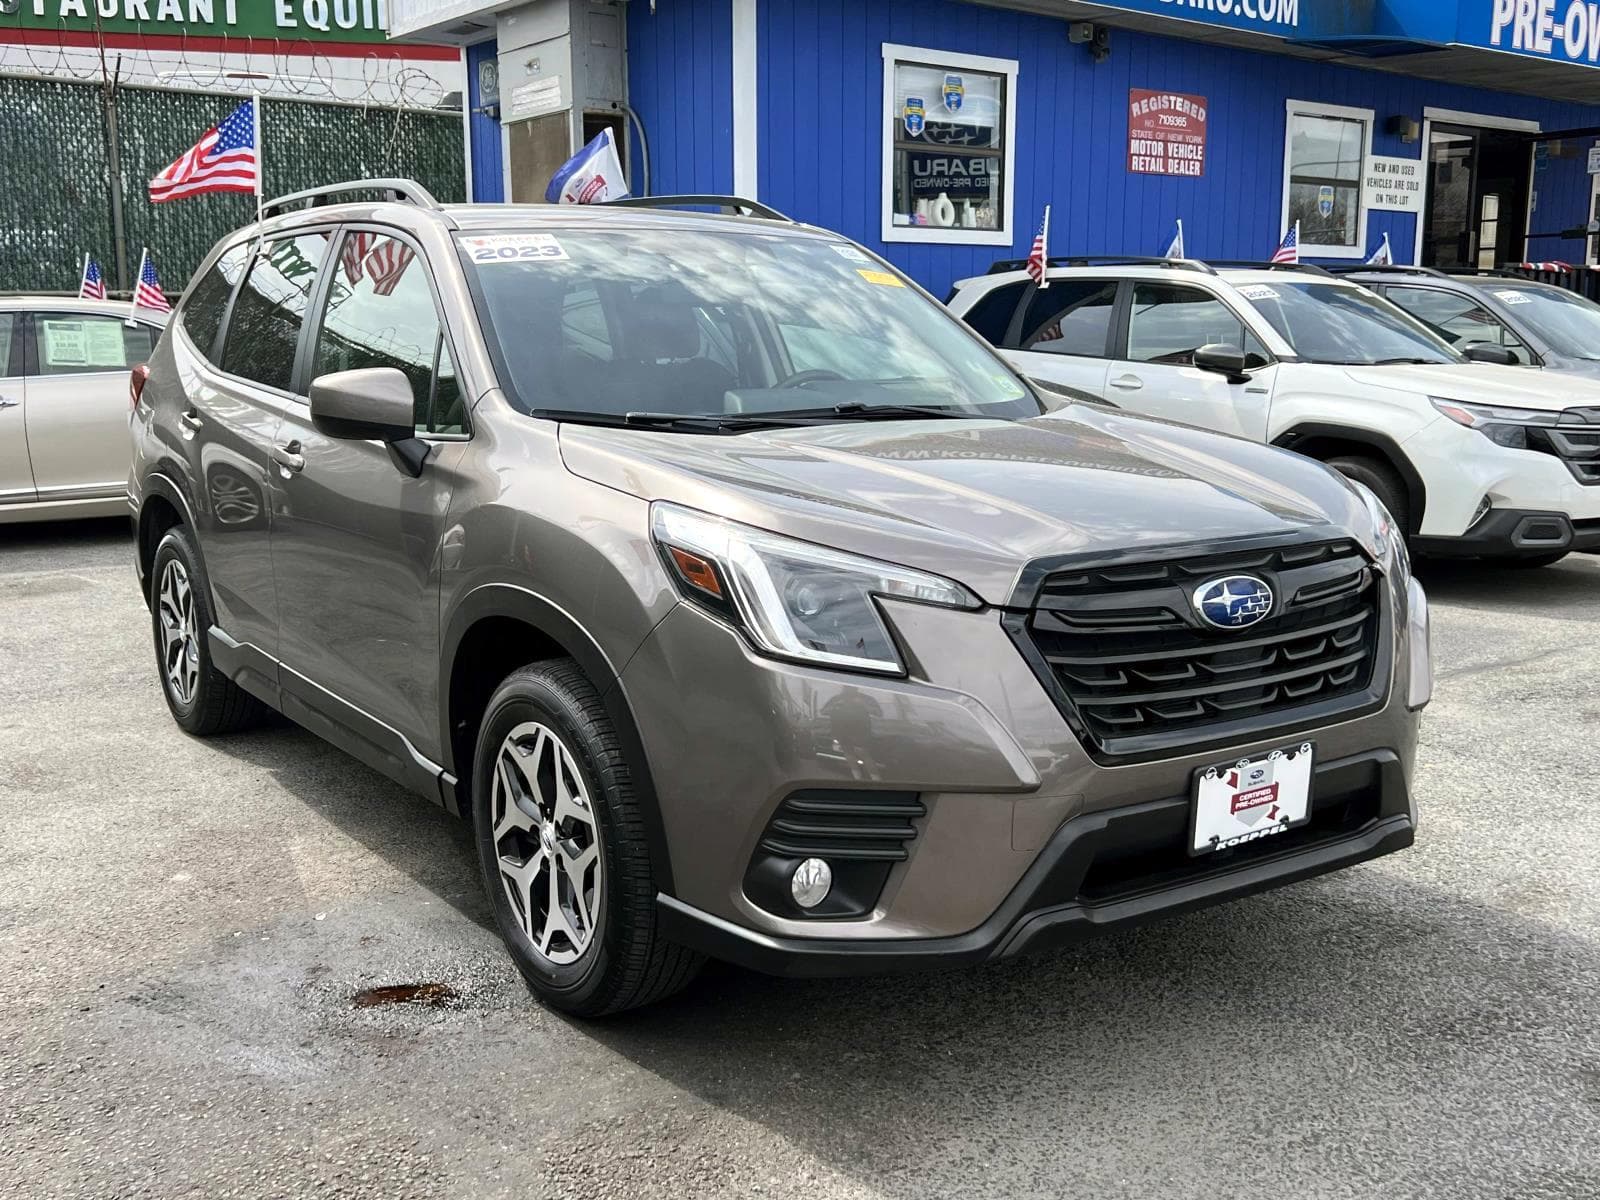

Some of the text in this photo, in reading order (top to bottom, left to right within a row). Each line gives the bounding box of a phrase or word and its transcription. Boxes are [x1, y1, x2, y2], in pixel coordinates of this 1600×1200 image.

[1132, 95, 1206, 122] REGISTERED
[1131, 129, 1203, 144] STATE OF NEW YORK
[1130, 139, 1203, 160] MOTOR VEHICLE
[1132, 156, 1201, 176] RETAIL DEALER
[1374, 163, 1415, 176] NEW AND USED
[1367, 177, 1419, 191] VEHICLES ARE SOLD
[1375, 193, 1409, 205] ON THIS LOT
[474, 245, 562, 260] 2023
[1235, 794, 1274, 810] PRE-OWNED
[1239, 788, 1272, 802] CERTIFIED
